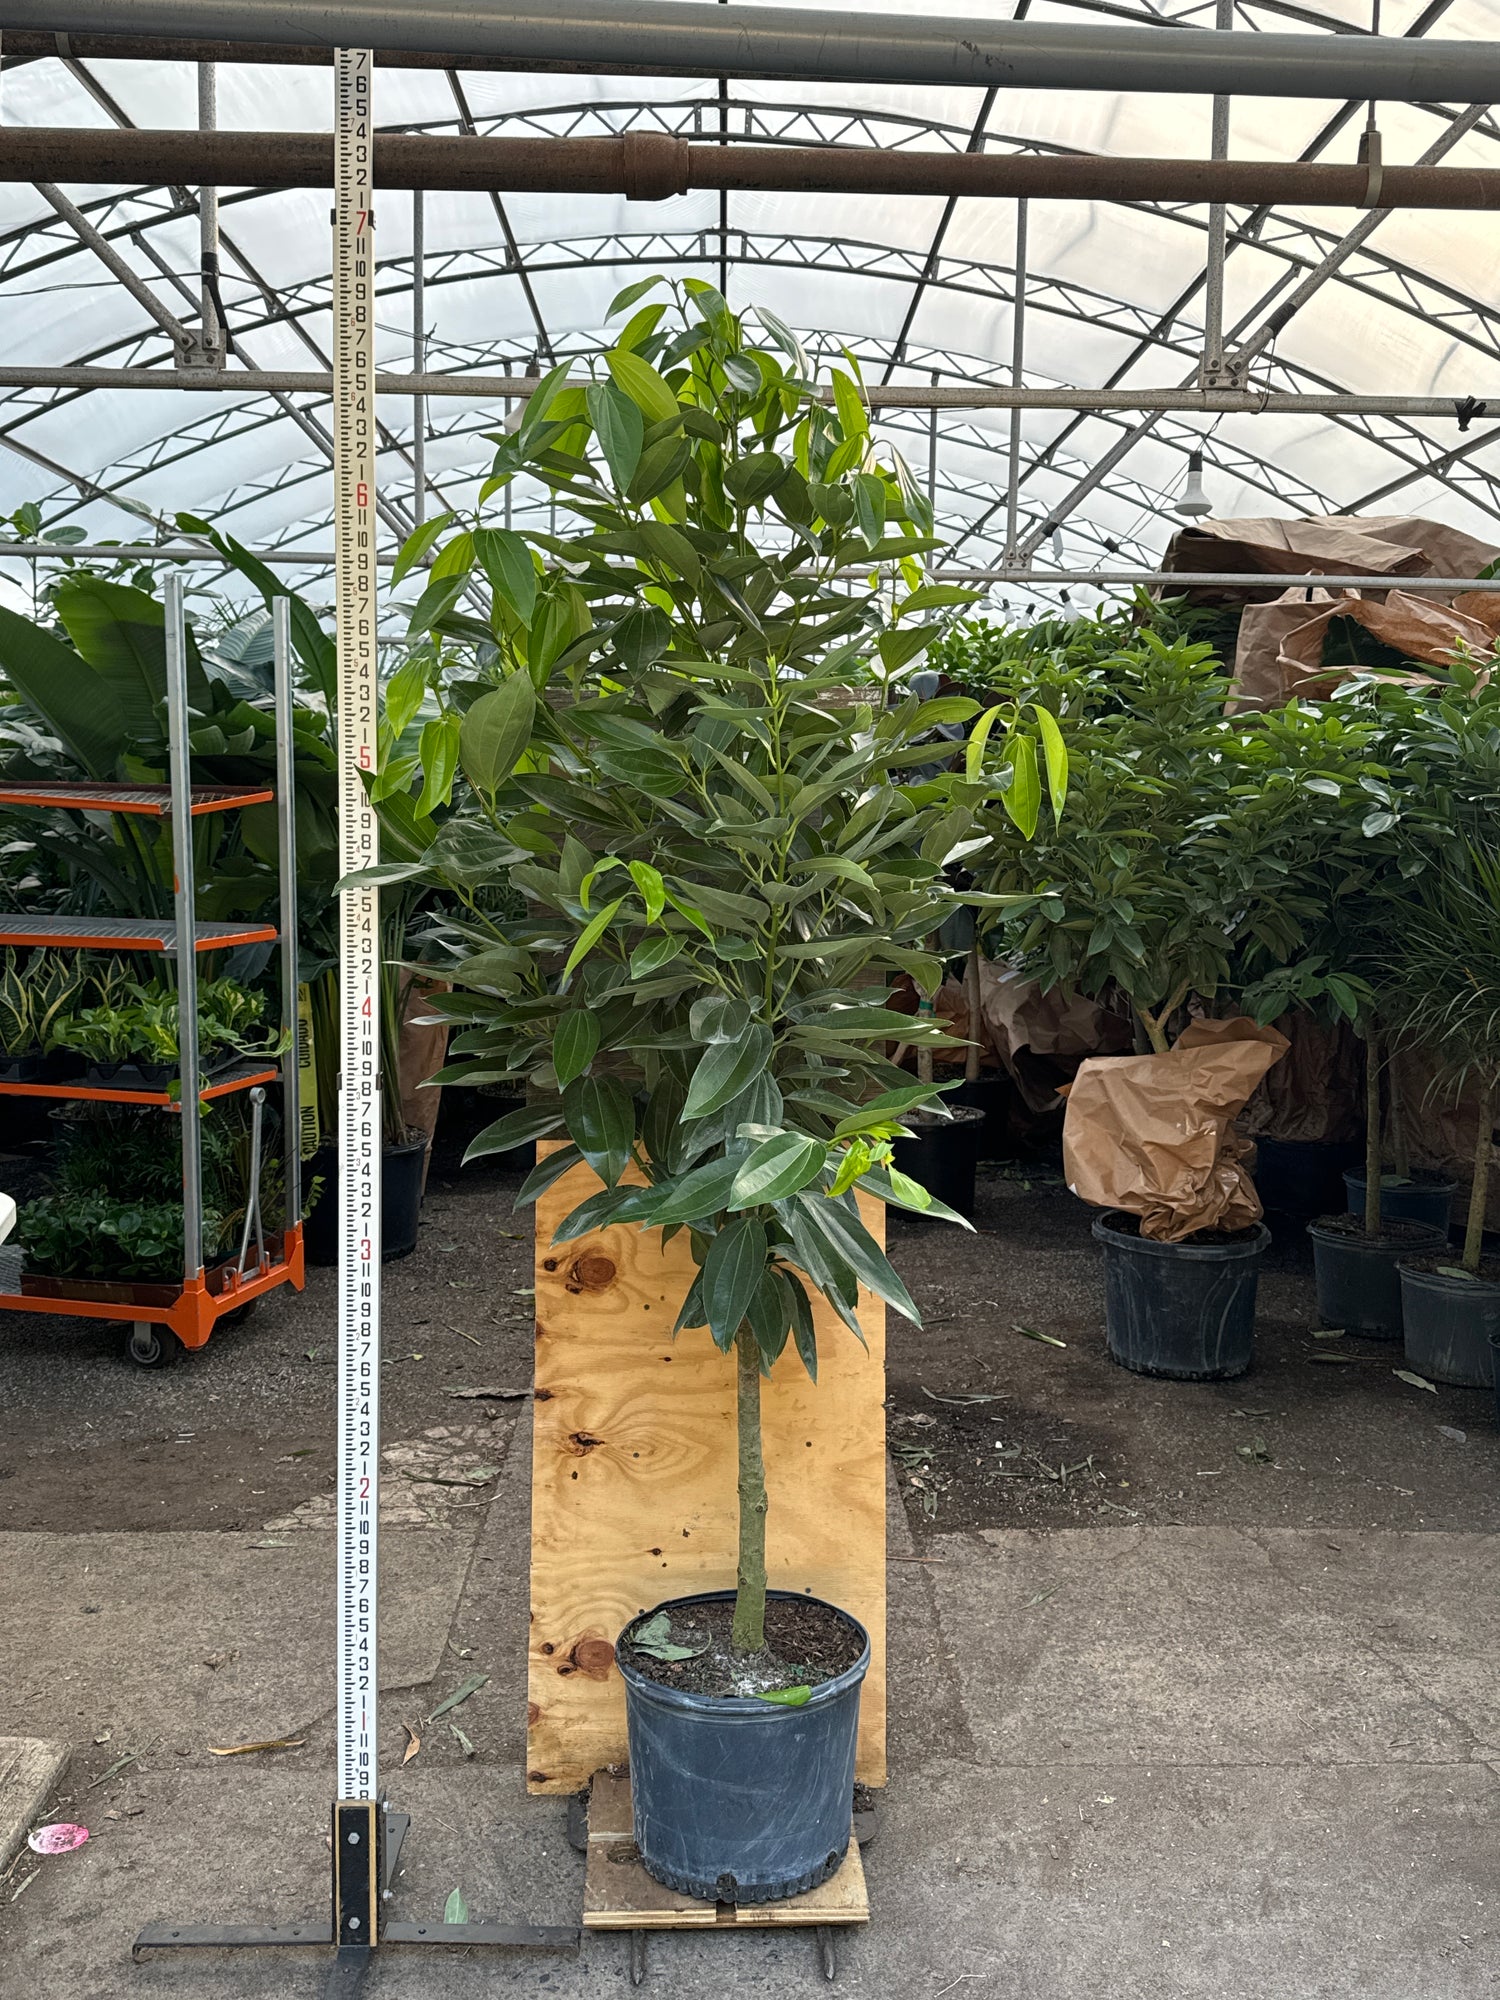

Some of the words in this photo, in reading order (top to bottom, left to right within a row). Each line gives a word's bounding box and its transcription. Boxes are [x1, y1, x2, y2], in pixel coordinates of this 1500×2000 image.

[356, 53, 366, 70] 7
[357, 77, 366, 93] 6
[357, 99, 366, 117] 5
[356, 122, 366, 139] 4
[357, 145, 366, 163] 3
[356, 169, 367, 186] 2
[356, 211, 366, 235] 7
[357, 237, 365, 254] 11
[356, 260, 366, 277] 10
[356, 283, 366, 300] 9
[356, 306, 366, 323] 8
[356, 329, 366, 346] 7
[356, 352, 366, 369] 6
[356, 374, 366, 391] 5
[356, 396, 366, 413] 4
[356, 419, 366, 436] 3
[357, 442, 367, 458] 2
[357, 483, 367, 507] 6
[358, 509, 366, 525] 11
[358, 531, 368, 547] 10
[358, 553, 368, 570] 9
[358, 575, 368, 592] 8
[359, 598, 368, 614] 7
[359, 619, 369, 636] 6
[359, 641, 369, 657] 5
[359, 662, 369, 679] 4
[360, 685, 369, 701] 3
[360, 706, 370, 722] 2
[360, 746, 370, 768] 5
[361, 813, 371, 829] 9
[361, 834, 371, 850] 8
[362, 855, 371, 870] 7
[362, 897, 371, 912] 5
[362, 917, 371, 932] 4
[362, 938, 371, 953] 3
[362, 959, 372, 974] 2
[362, 996, 371, 1017] 4
[363, 1021, 370, 1035] 11
[362, 1041, 372, 1055] 10
[362, 1061, 372, 1076] 9
[362, 1082, 371, 1096] 8
[362, 1102, 371, 1116] 7
[301, 1105, 317, 1154] CAUTION
[362, 1122, 371, 1137] 6
[362, 1142, 371, 1157] 5
[362, 1162, 371, 1177] 4
[362, 1182, 371, 1197] 3
[362, 1203, 371, 1217] 2
[361, 1239, 370, 1260] 3
[363, 1263, 370, 1277] 11
[361, 1283, 371, 1297] 10
[361, 1302, 370, 1317] 9
[361, 1322, 370, 1337] 8
[361, 1342, 370, 1357] 7
[361, 1362, 370, 1376] 6
[361, 1382, 370, 1396] 5
[361, 1402, 370, 1416] 4
[361, 1421, 370, 1436] 3
[360, 1441, 369, 1456] 2
[360, 1478, 369, 1498] 2
[361, 1501, 368, 1515] 11
[360, 1520, 369, 1535] 10
[360, 1540, 369, 1554] 9
[360, 1560, 369, 1574] 8
[360, 1579, 368, 1593] 7
[359, 1599, 368, 1613] 6
[359, 1618, 368, 1632] 5
[359, 1637, 368, 1651] 4
[359, 1657, 368, 1671] 3
[359, 1676, 368, 1690] 2
[360, 1733, 367, 1747] 11
[360, 1752, 368, 1766] 10
[360, 1771, 369, 1785] 9
